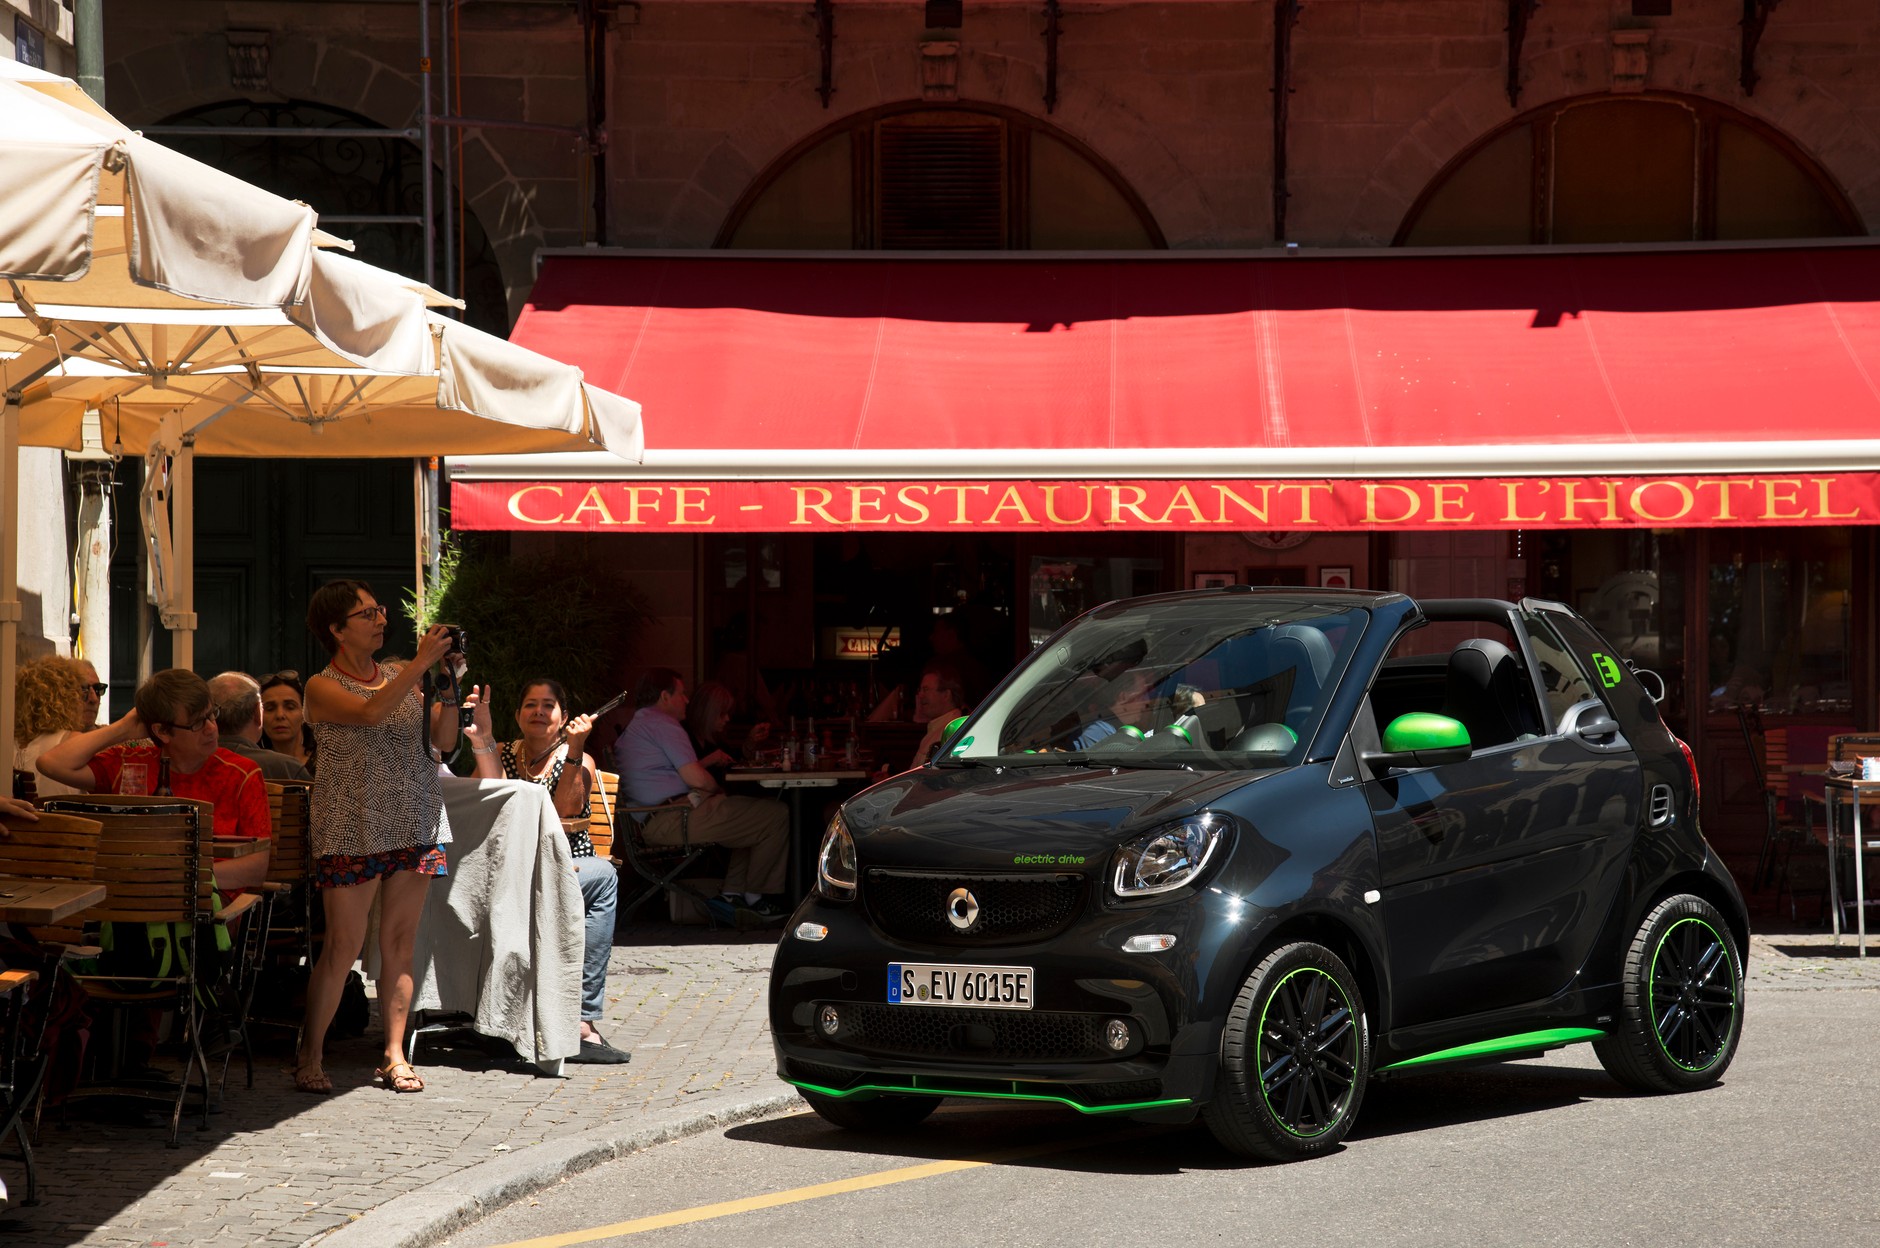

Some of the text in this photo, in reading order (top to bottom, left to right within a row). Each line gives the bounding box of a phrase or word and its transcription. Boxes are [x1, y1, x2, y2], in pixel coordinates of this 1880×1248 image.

[507, 485, 716, 525] CAFE
[789, 484, 1334, 525] RESTAURANT
[1359, 483, 1475, 523] DE
[1499, 478, 1861, 522] L'HOTEL
[1013, 854, 1086, 864] electric drive
[891, 987, 898, 997] D
[902, 969, 1029, 1004] S EV 6015E
